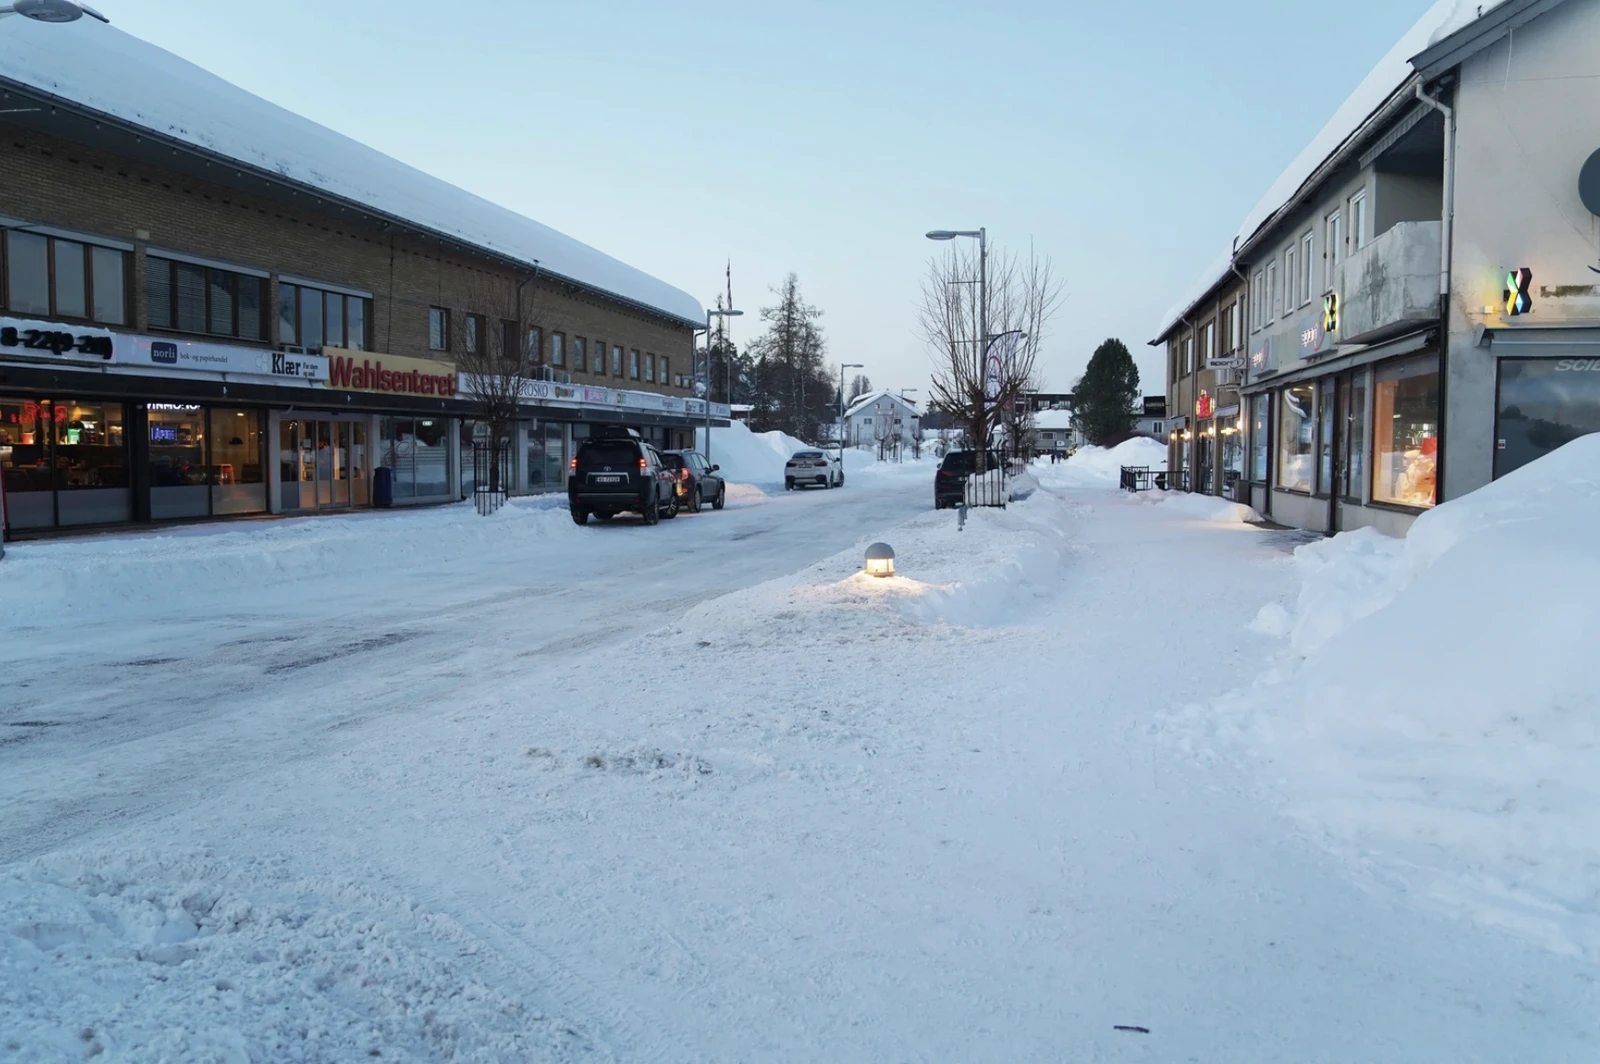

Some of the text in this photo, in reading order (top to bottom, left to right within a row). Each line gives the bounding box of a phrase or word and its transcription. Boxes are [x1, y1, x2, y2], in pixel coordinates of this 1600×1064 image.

[153, 347, 175, 359] norli
[272, 353, 301, 376] Klær
[328, 354, 456, 396] Wahlsenteret
